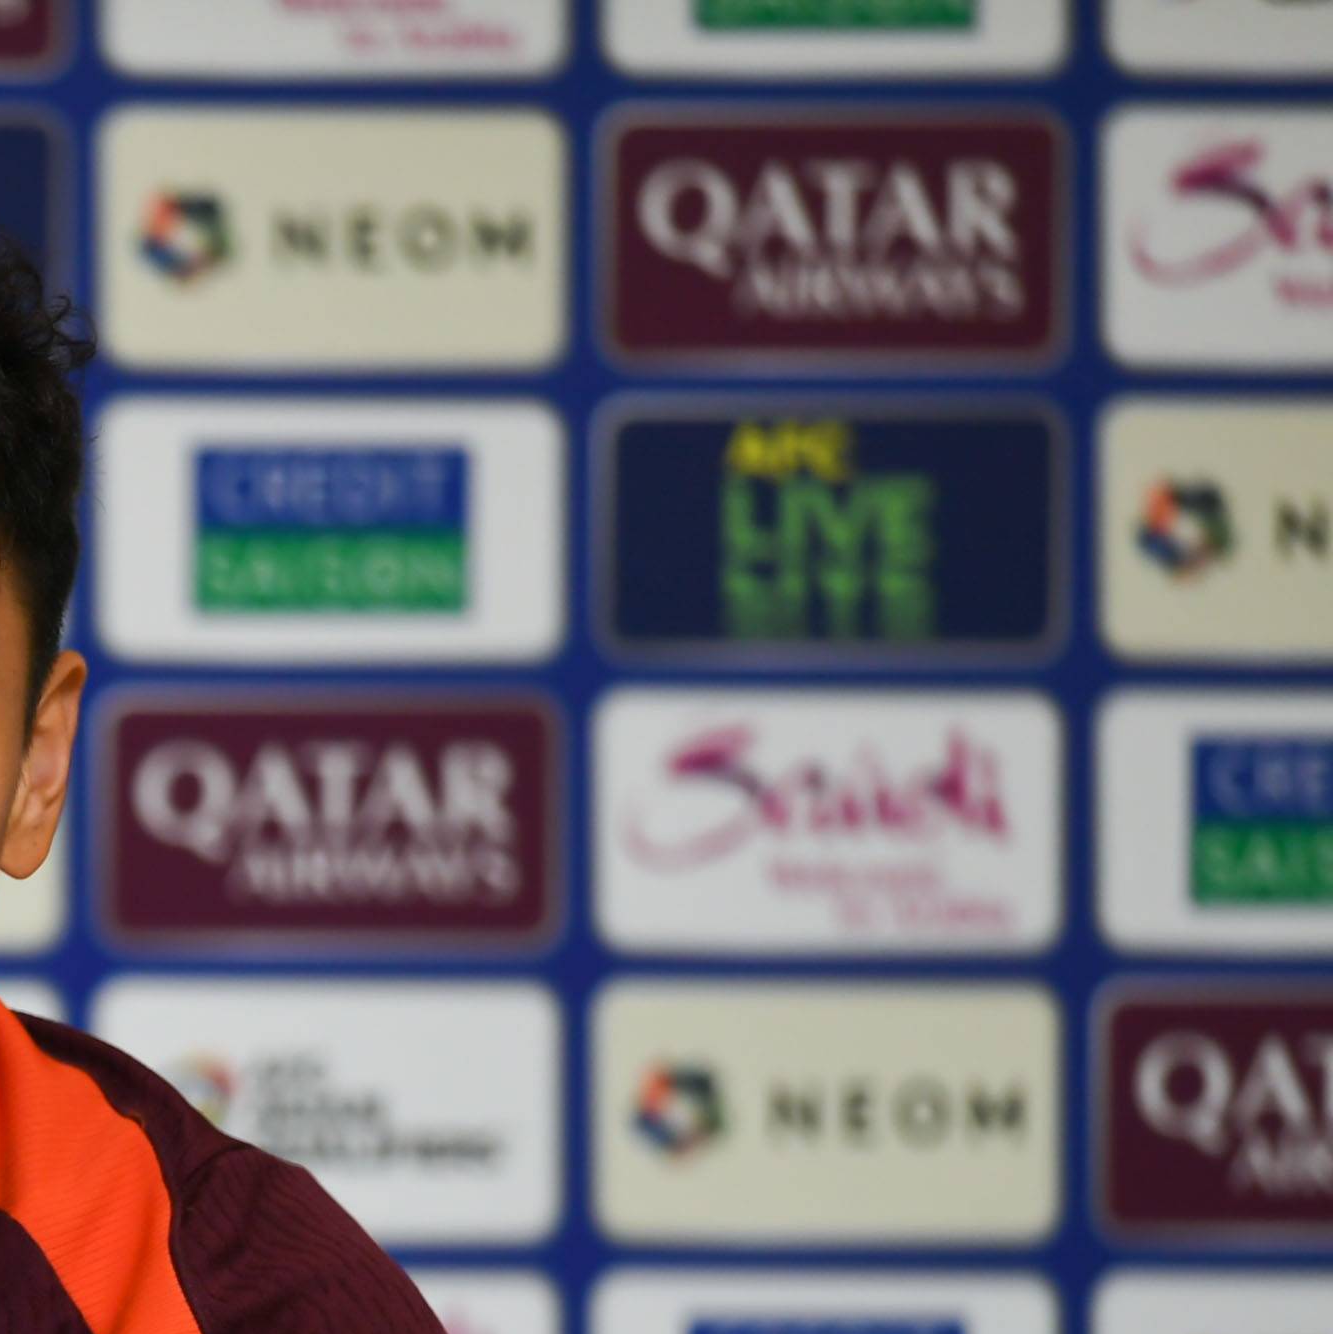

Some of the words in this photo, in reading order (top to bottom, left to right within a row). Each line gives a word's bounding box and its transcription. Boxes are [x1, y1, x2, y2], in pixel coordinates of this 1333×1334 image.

[273, 205, 533, 274] NEOM
[636, 158, 1021, 278] QATAR
[745, 254, 1025, 318] AIRWAYS
[218, 462, 451, 530] CREDIT
[205, 540, 465, 605] SAISON
[133, 738, 515, 862] QATAR
[1208, 745, 1333, 815] CRE
[235, 845, 520, 902] AIRWAYS
[765, 1072, 1025, 1145] NEOM
